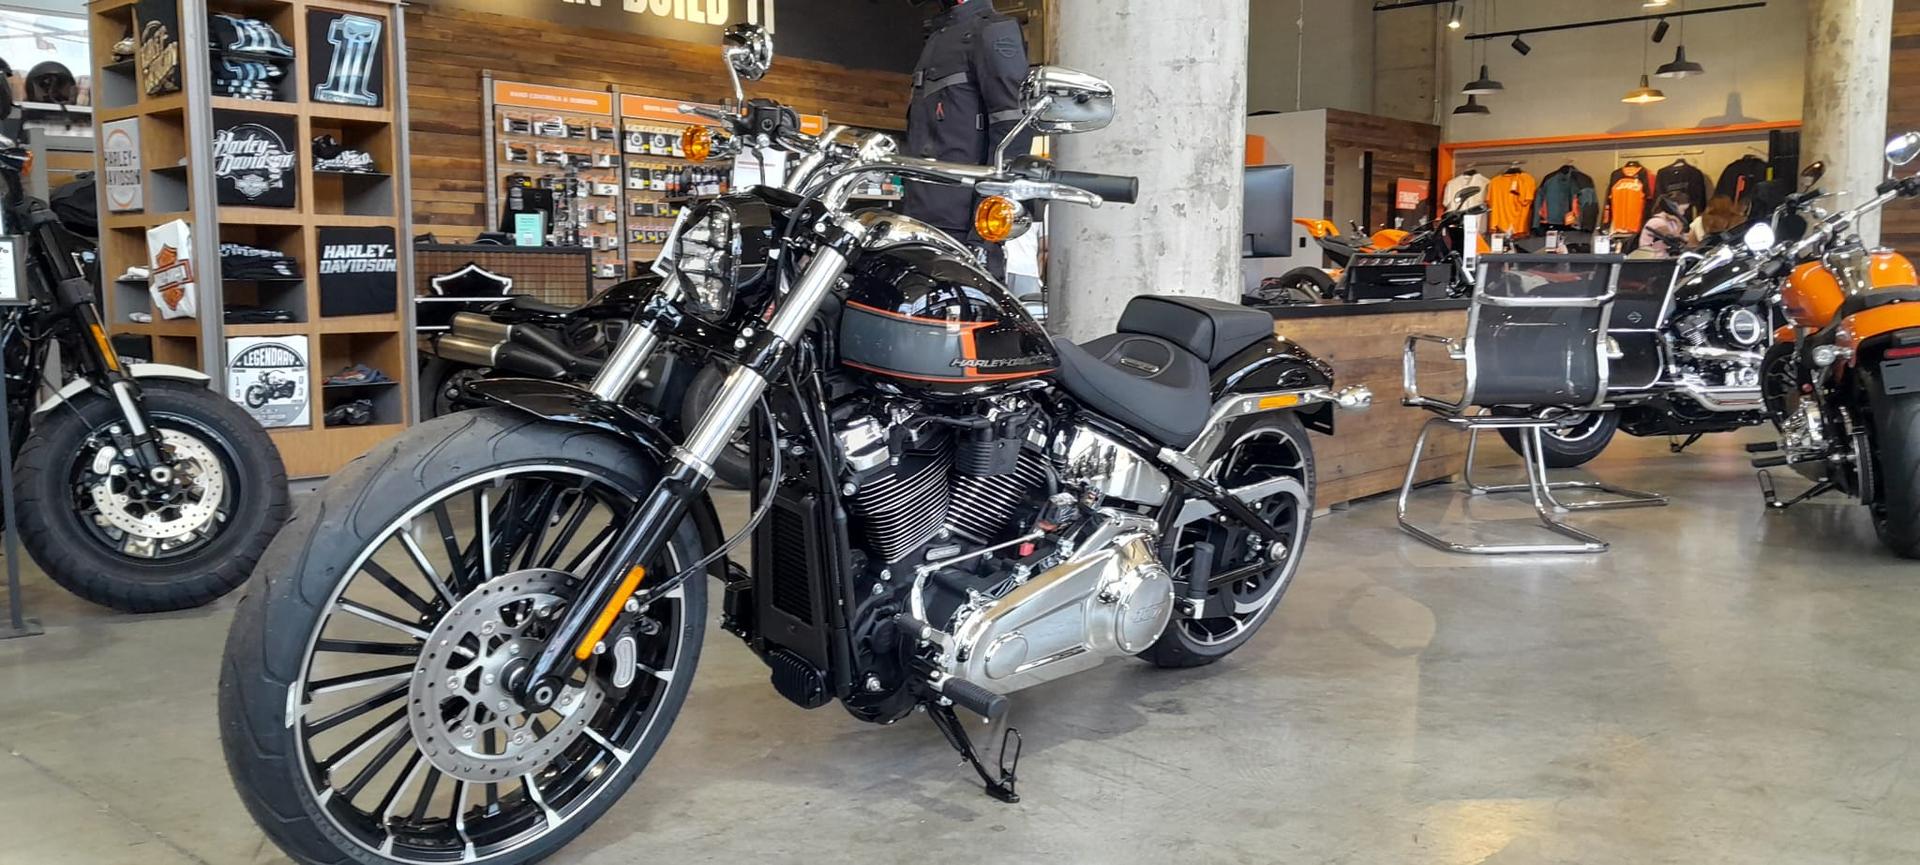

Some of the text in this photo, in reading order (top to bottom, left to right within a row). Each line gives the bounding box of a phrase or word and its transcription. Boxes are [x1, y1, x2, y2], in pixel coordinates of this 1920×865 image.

[323, 244, 394, 259] HARLEY-
[319, 258, 398, 274] DAVIDSON
[243, 347, 296, 366] LEGENDARY
